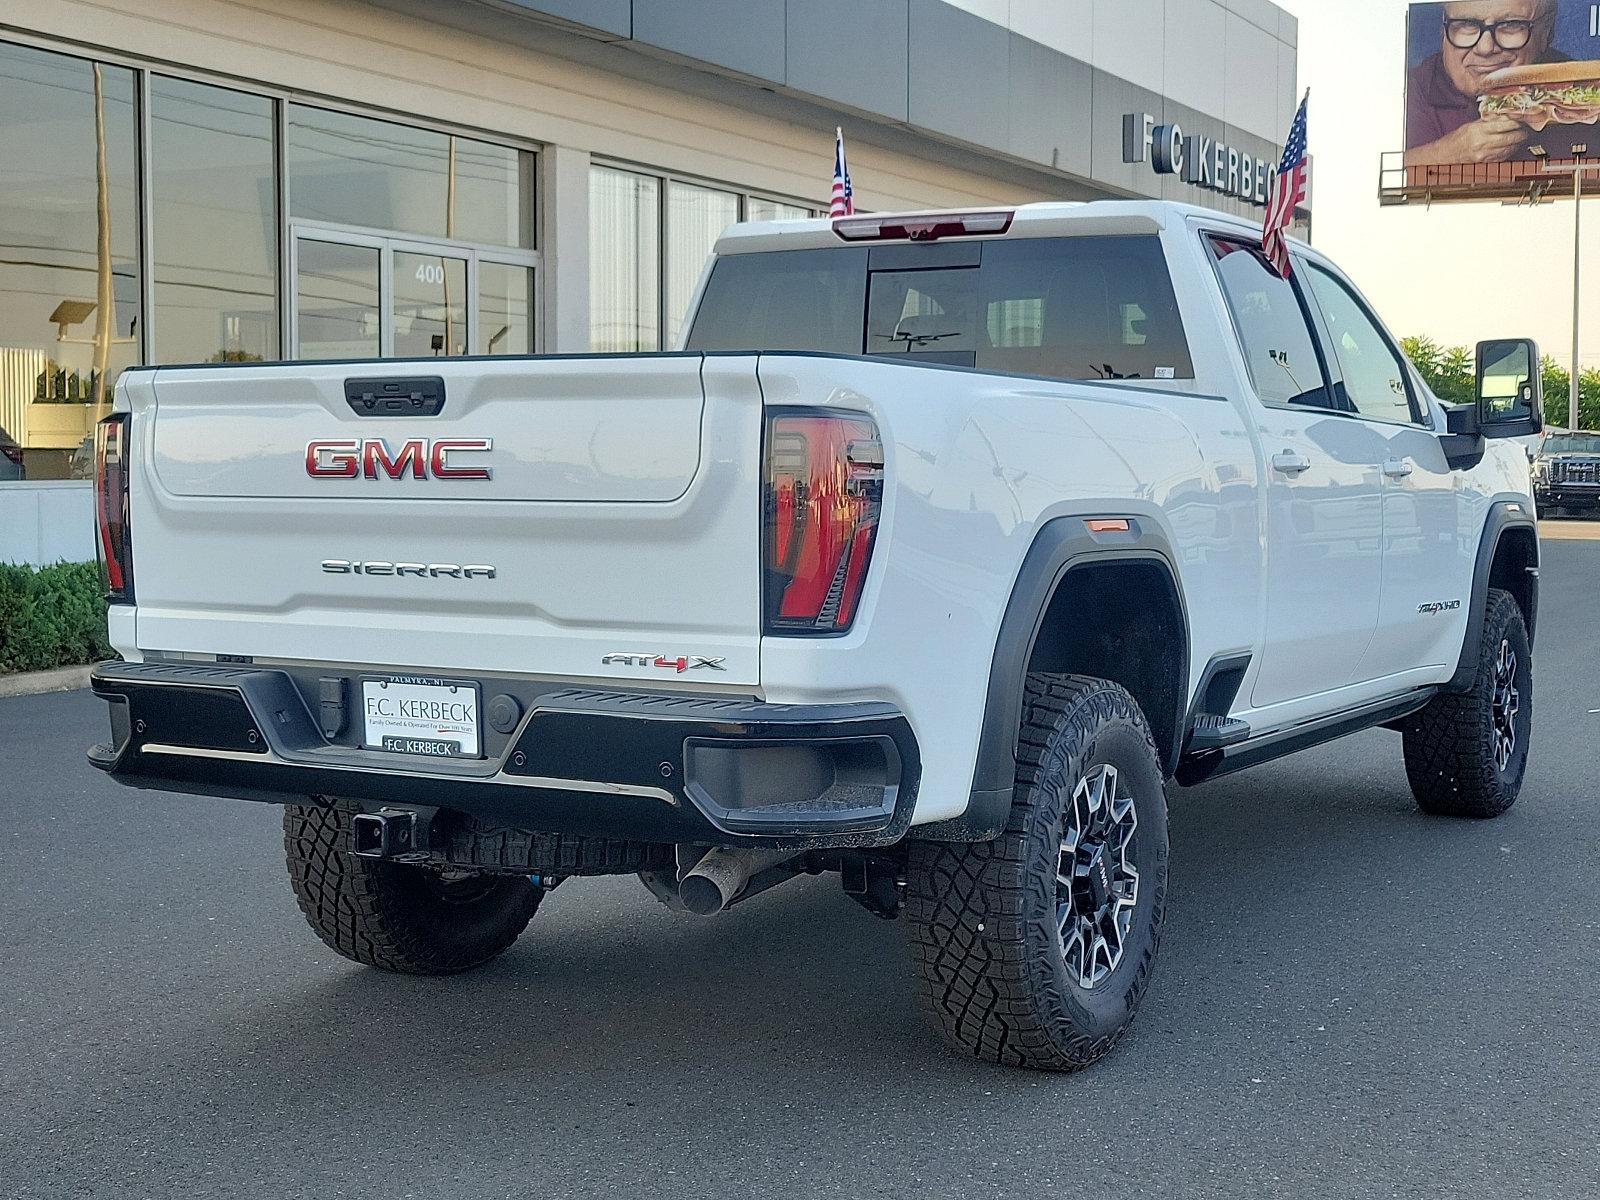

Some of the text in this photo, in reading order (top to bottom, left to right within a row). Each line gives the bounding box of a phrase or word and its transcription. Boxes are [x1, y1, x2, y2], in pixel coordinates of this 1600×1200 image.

[1197, 134, 1278, 205] KERBEC
[415, 264, 445, 285] 400
[305, 437, 494, 481] GMC
[320, 558, 497, 580] SIERRA
[601, 651, 728, 674] AT4X
[367, 697, 474, 723] F.C. KERBECK
[385, 719, 403, 727] Owned
[387, 739, 452, 755] F.C. KERBECK
